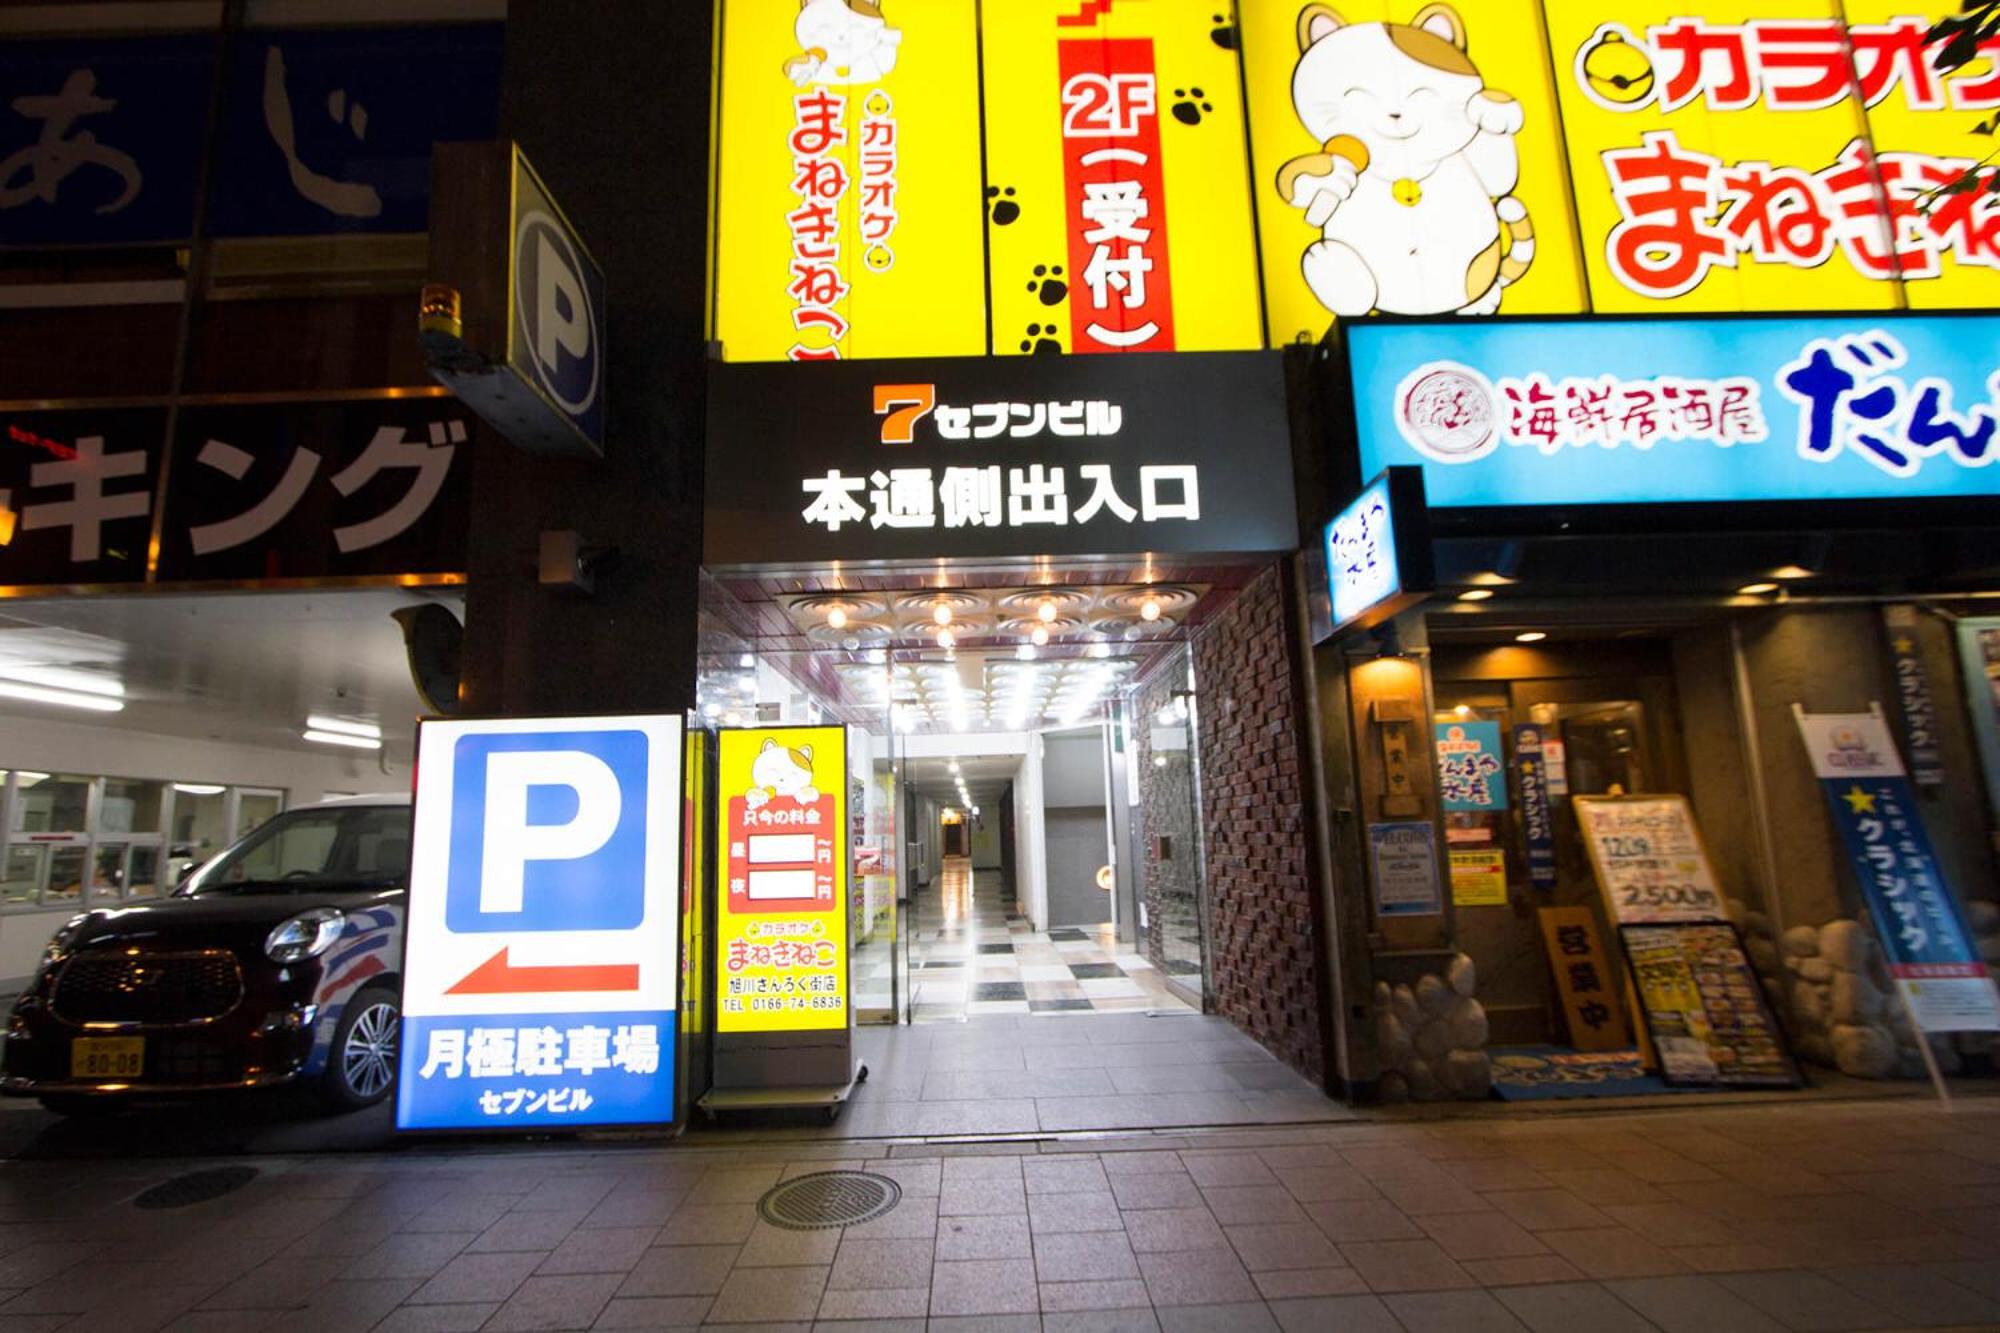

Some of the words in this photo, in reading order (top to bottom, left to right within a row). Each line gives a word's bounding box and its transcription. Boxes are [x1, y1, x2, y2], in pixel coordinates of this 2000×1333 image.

[861, 119, 897, 244] カラオケ
[537, 229, 590, 372] P
[873, 384, 935, 444] 7
[934, 399, 1123, 440] セブンビル
[1502, 380, 1765, 445] 海鮮居酒屋
[0, 421, 467, 563] キング
[801, 463, 1201, 532] 本通側出入口
[479, 750, 622, 914] P
[743, 808, 821, 827] 只今の料金
[730, 878, 746, 894] 夜
[1857, 818, 1928, 951] クラシック
[726, 937, 837, 974] まねきねこ
[762, 921, 813, 938] カラオケ
[723, 997, 744, 1012] TEL
[419, 1025, 660, 1080] 月極駐車場
[478, 1086, 594, 1115] セブンビル
